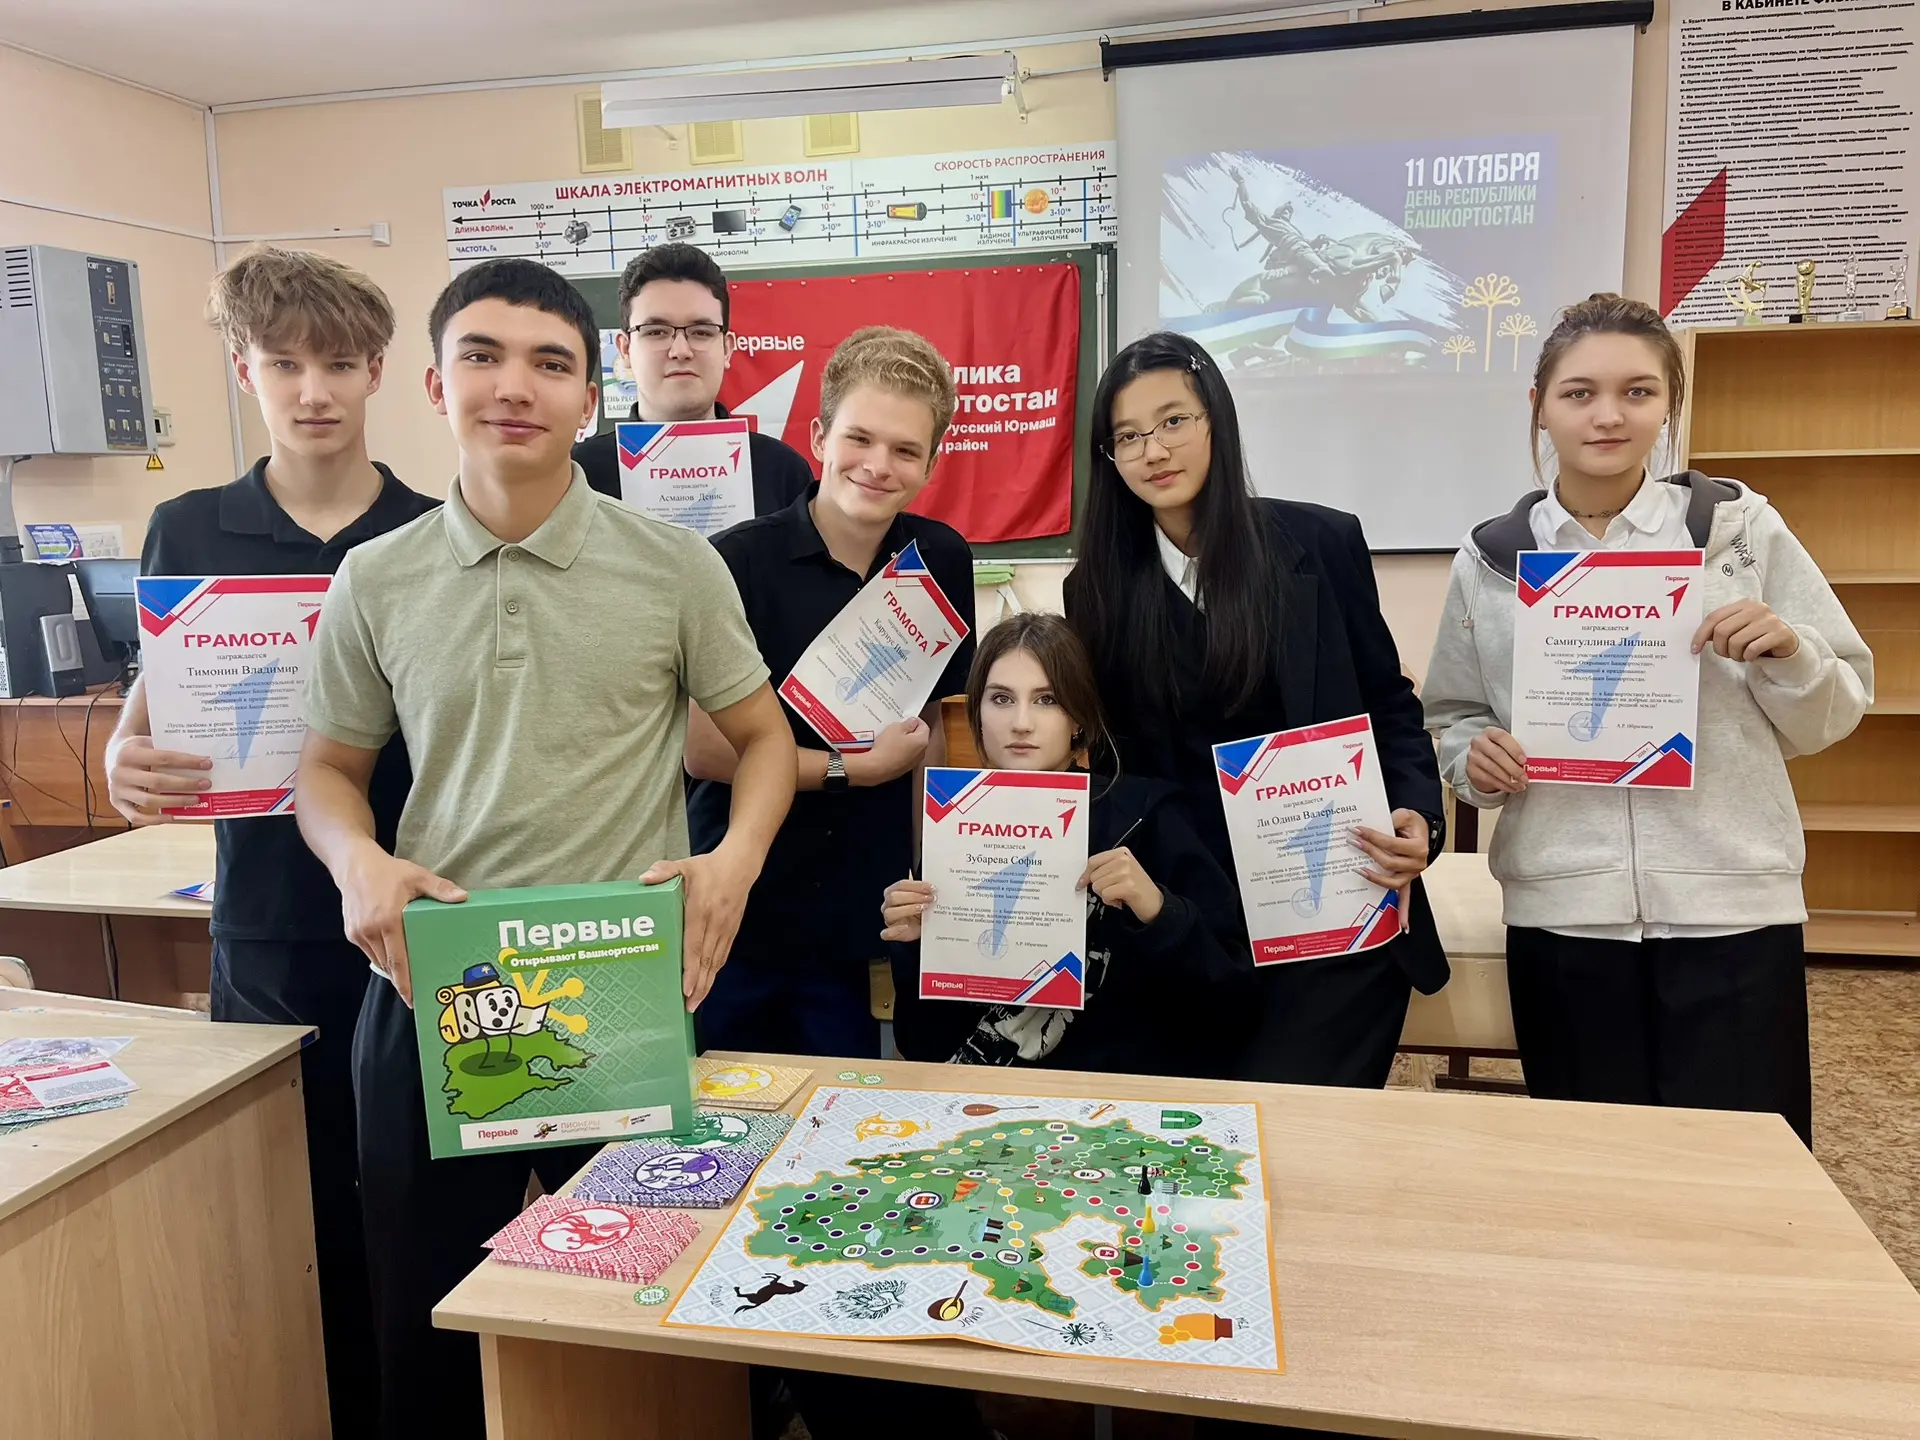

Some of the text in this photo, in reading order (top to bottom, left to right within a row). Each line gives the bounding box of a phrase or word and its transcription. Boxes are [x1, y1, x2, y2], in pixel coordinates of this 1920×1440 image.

[1722, 1, 1731, 11] В
[934, 150, 1105, 171] СКОРОСТЬ РАСПРОСТРАНЕНИЯ
[1405, 152, 1540, 187] 11 ОКТЯБРЯ
[556, 169, 828, 199] ШКАЛА ЭЛЕКТРОМАГНИТНЫХ ВОЛН
[491, 198, 516, 206] РОСТА
[1404, 184, 1537, 209] ДЕНЬ РЕСПУБЛИКИ
[1404, 204, 1534, 229] БАШКОРТОСТАН
[455, 226, 480, 234] ДЛИНА
[481, 224, 508, 232] ВОЛНЫ,
[1017, 228, 1083, 237] УЛЬТРАФИОЛЕТОВОЕ
[871, 236, 957, 247] ИНФРАКРАСНОЕ ИЗЛУЧЕНИЕ
[456, 245, 489, 253] ЧАСТОТА,
[952, 364, 1021, 385] лика
[1004, 417, 1056, 434] Юрмаш
[945, 439, 988, 454] район
[649, 466, 728, 479] ГРАМОТА
[659, 492, 723, 502] Асманов Денис
[1553, 605, 1661, 619] ГРАМОТА
[883, 590, 928, 653] ГРАМОТА
[184, 632, 297, 648] ГРАМОТА
[1545, 636, 1666, 648] Самигуллина Лилиана
[216, 653, 267, 661] награждается
[186, 665, 299, 677] Тимонин Владимир
[789, 684, 812, 709] Первые
[1524, 764, 1558, 773] Первые
[1255, 774, 1348, 801] ГРАМОТА
[1283, 796, 1324, 809] награждается
[1256, 818, 1270, 829] Ли
[1302, 803, 1358, 820] Валерьевна
[958, 822, 1052, 839] ГРАМОТА
[965, 853, 1042, 867] Зубарева София
[498, 915, 655, 949] Первые
[510, 942, 659, 968] Открывают Башкортостан
[1263, 944, 1295, 955] Первые
[931, 979, 963, 991] Первые
[561, 1120, 600, 1129] ПИОНЕРЫ
[477, 1126, 518, 1140] Первые
